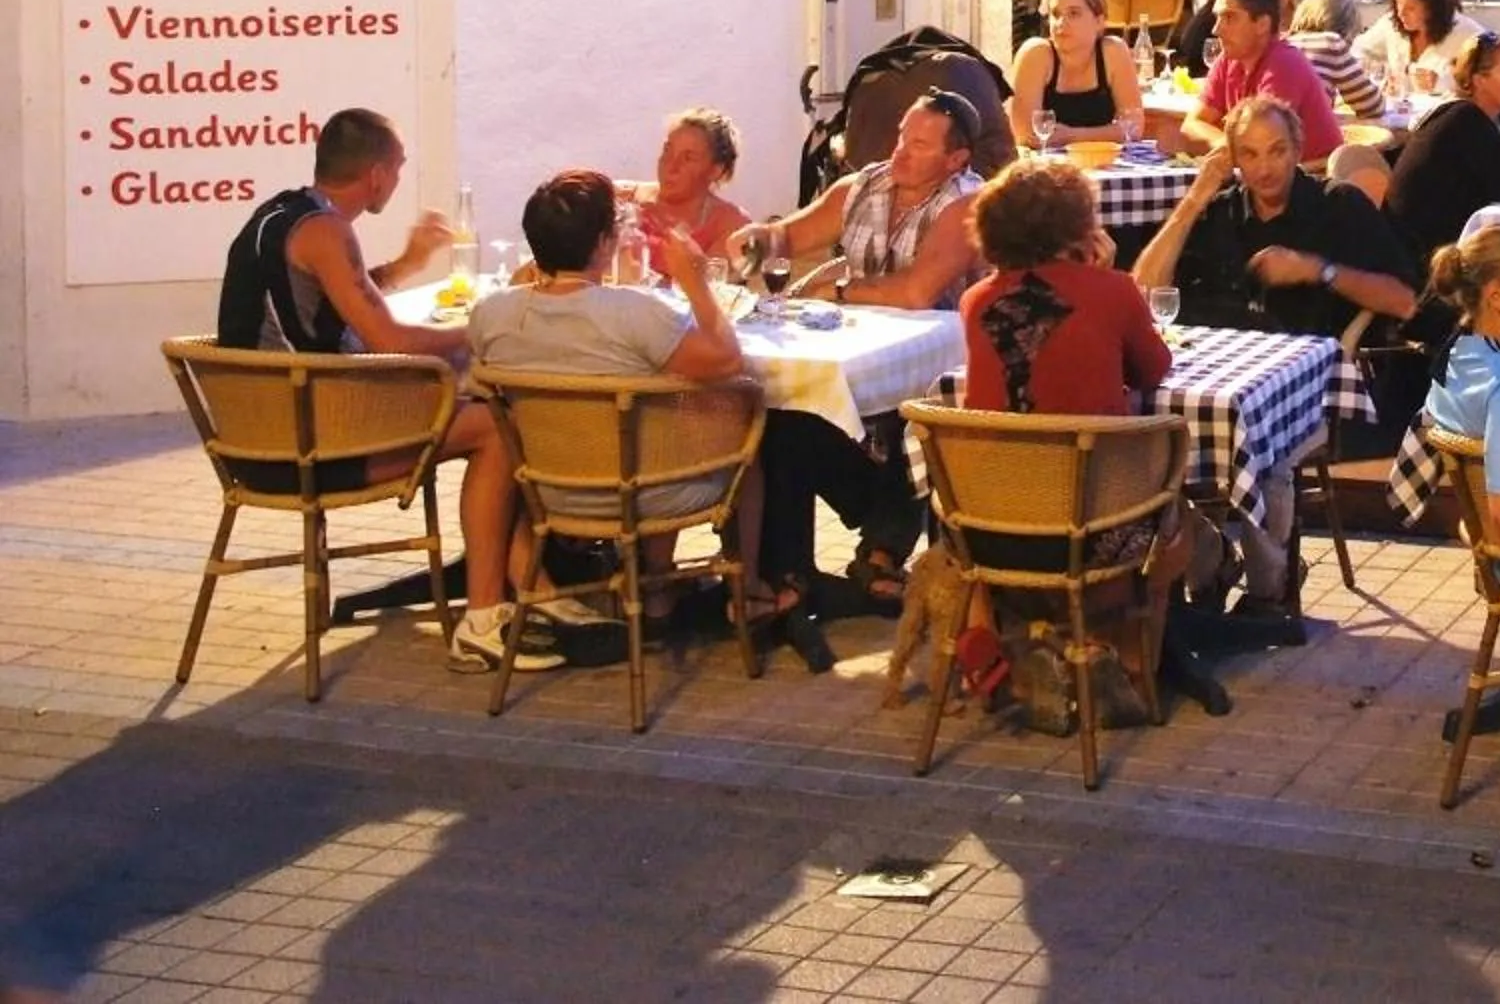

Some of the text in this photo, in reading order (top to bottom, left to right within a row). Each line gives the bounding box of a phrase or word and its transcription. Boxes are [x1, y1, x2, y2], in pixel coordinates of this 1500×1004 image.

[108, 6, 400, 41] Viennoiseries
[109, 62, 279, 95] Salades
[111, 171, 256, 206] Glaces
